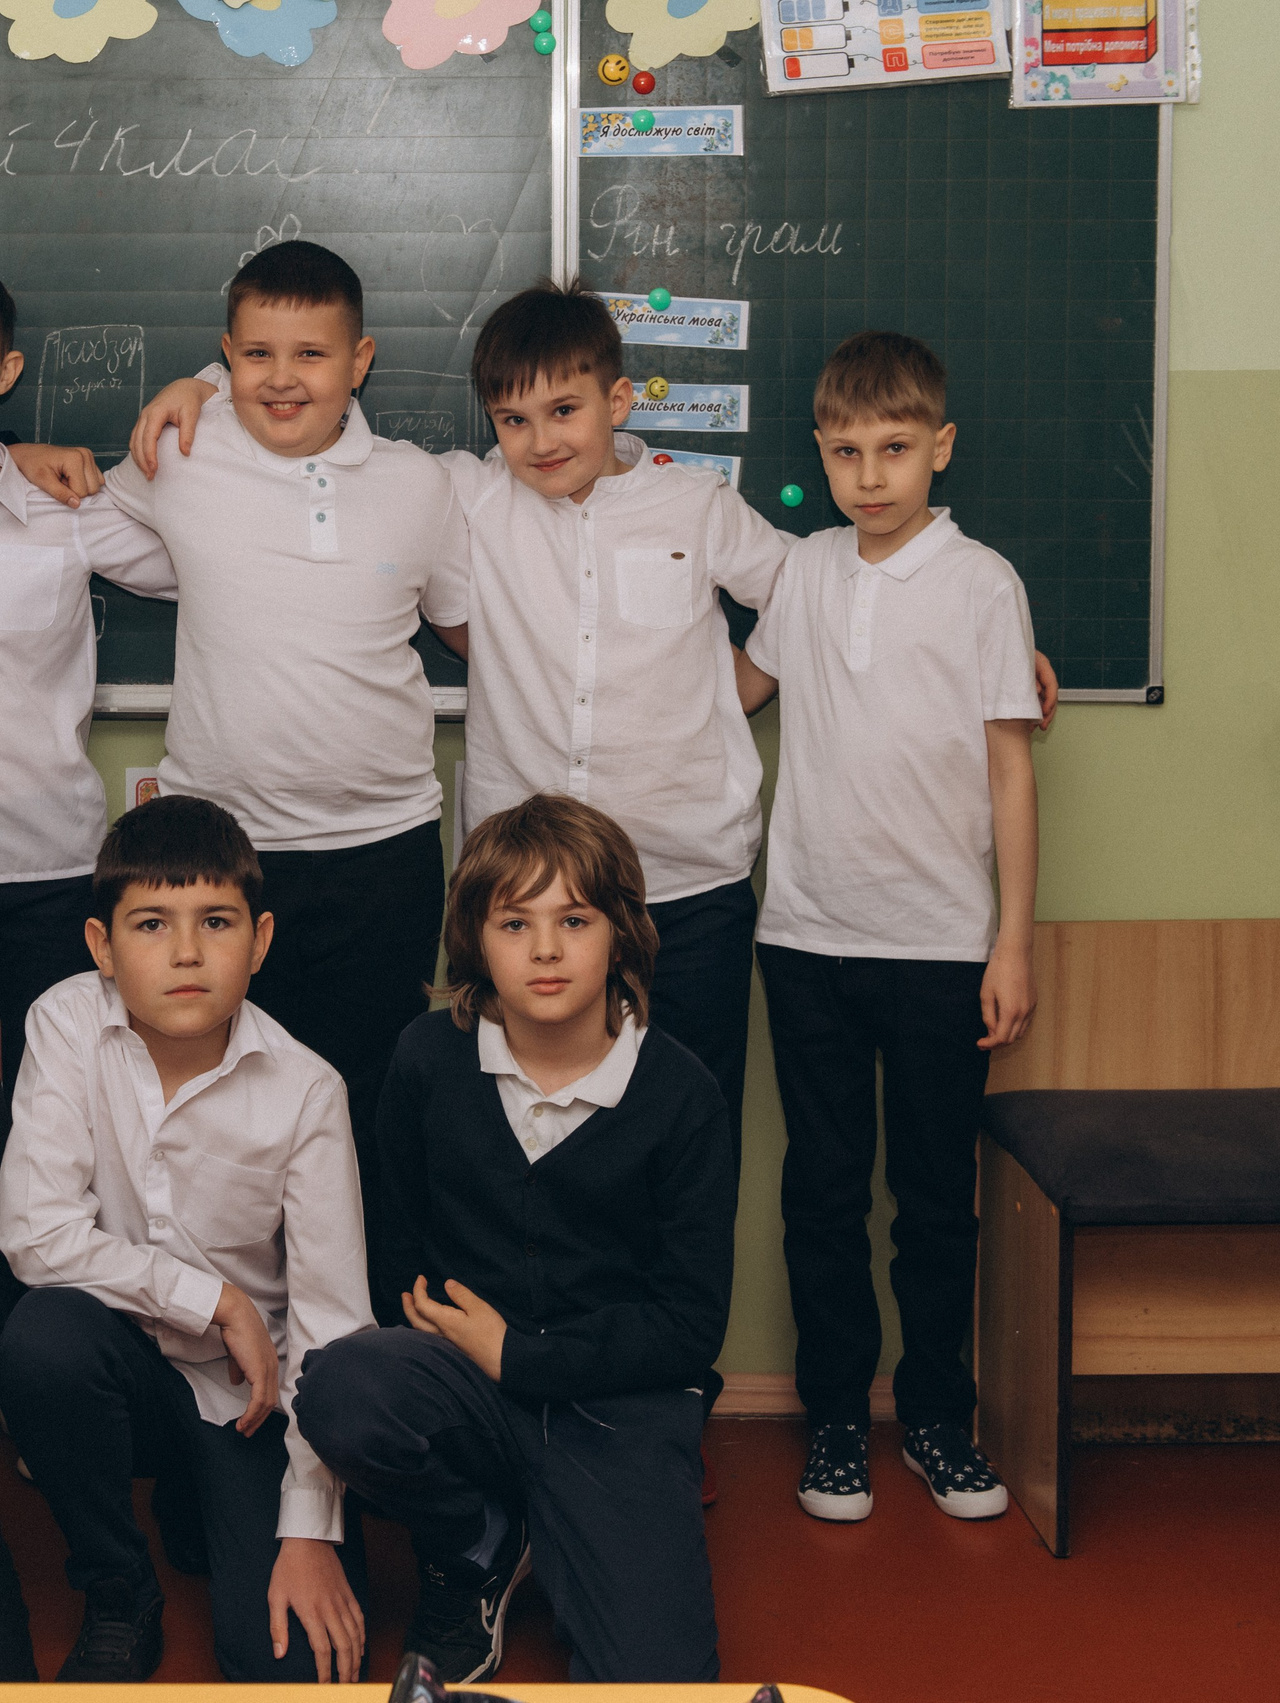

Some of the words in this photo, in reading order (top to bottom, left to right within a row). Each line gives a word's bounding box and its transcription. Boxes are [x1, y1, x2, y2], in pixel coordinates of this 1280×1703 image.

[1043, 39, 1064, 53] Мені
[1065, 38, 1103, 55] потрібна
[600, 125, 610, 138] Я
[686, 122, 716, 137] світ
[614, 308, 686, 325] Українська
[688, 316, 723, 328] мова
[631, 398, 685, 411] глійська
[687, 402, 722, 413] мова
